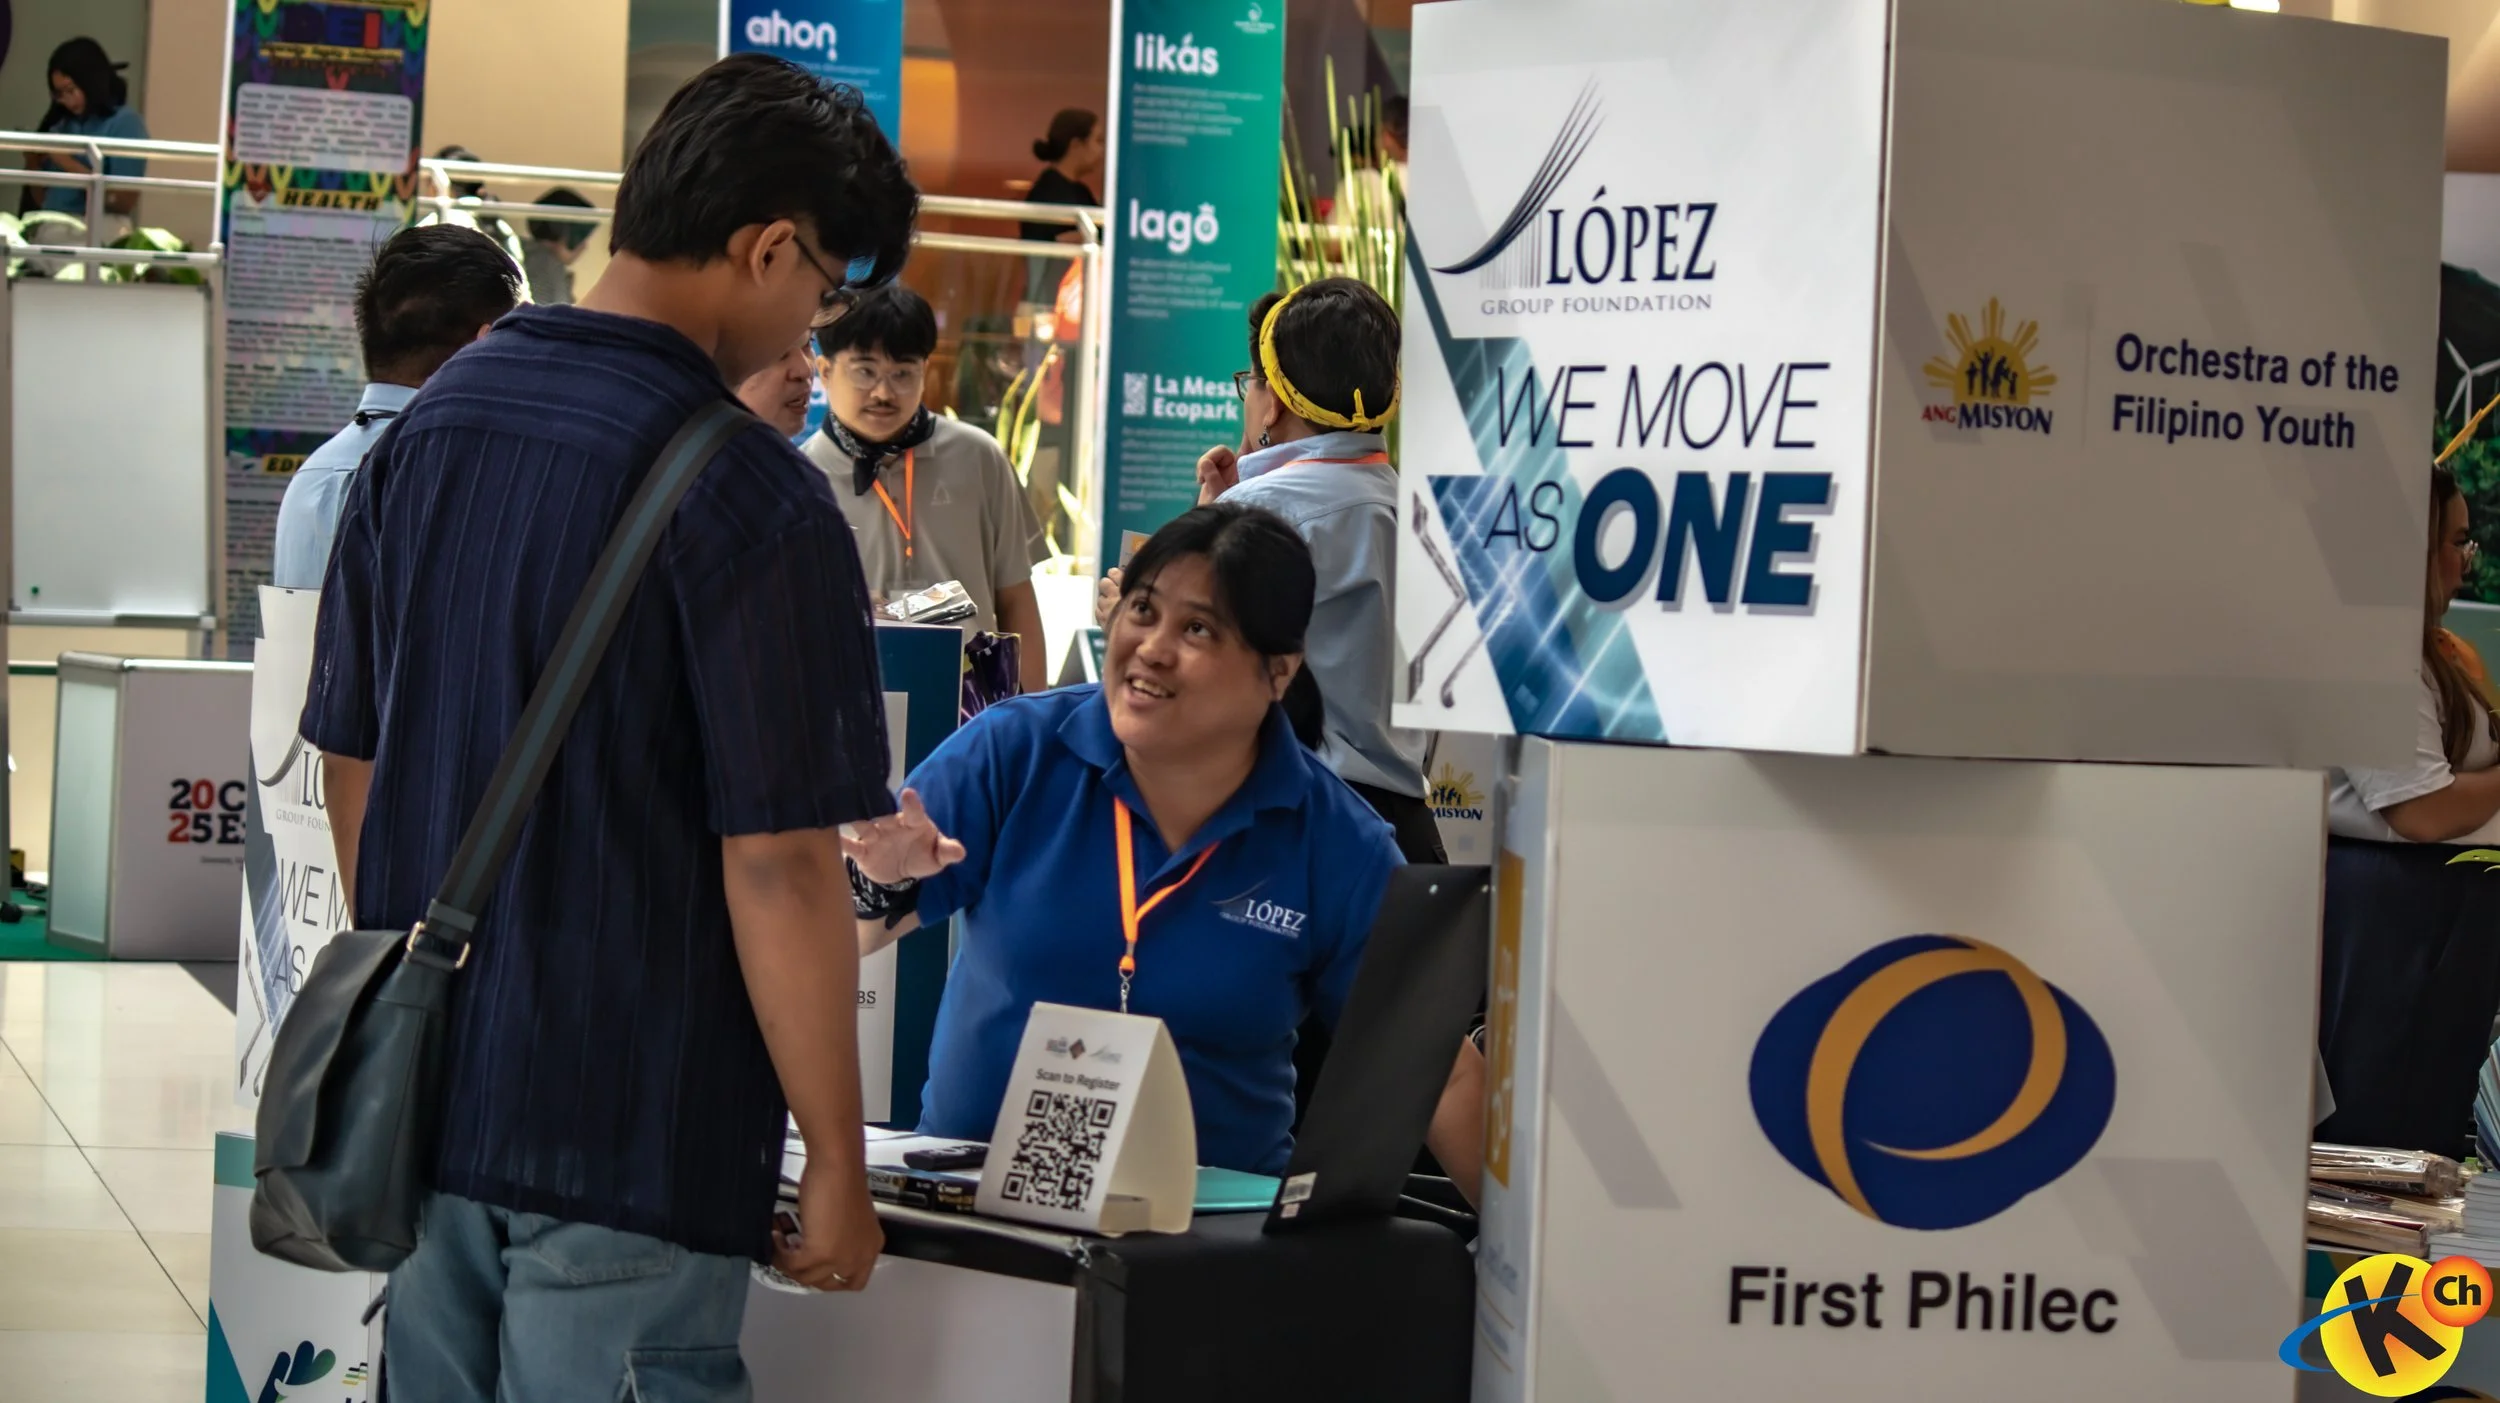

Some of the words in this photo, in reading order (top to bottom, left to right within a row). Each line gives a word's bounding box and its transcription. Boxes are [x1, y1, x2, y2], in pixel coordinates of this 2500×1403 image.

[284, 189, 380, 210] HEALTH
[1546, 185, 1718, 285] LÓPEZ
[1480, 298, 1554, 315] GROUP
[1563, 294, 1713, 313] FOUNDATION
[2115, 332, 2289, 384] Orchestra
[2300, 351, 2337, 387] of
[2345, 355, 2400, 393] the
[1154, 374, 1180, 396] La
[1183, 376, 1239, 398] Mesa
[1498, 364, 1607, 448] WE
[1617, 361, 1831, 450] MOVE
[1152, 397, 1240, 424] Ecopark
[1921, 405, 1956, 424] ANG
[1958, 402, 2053, 435] MISYON
[2112, 394, 2245, 444] Filipino
[2256, 405, 2356, 449] Youth
[1483, 481, 1564, 552] AS
[1573, 466, 1837, 613] ONE
[275, 808, 305, 827] GROUP
[281, 858, 324, 927] WE
[1245, 898, 1307, 931] LÓPEZ
[272, 943, 306, 996] AS
[1035, 1067, 1062, 1082] Scan
[1063, 1073, 1076, 1084] to
[1077, 1074, 1121, 1091] Register
[1728, 1265, 1884, 1329] First
[1908, 1270, 2119, 1335] Philec
